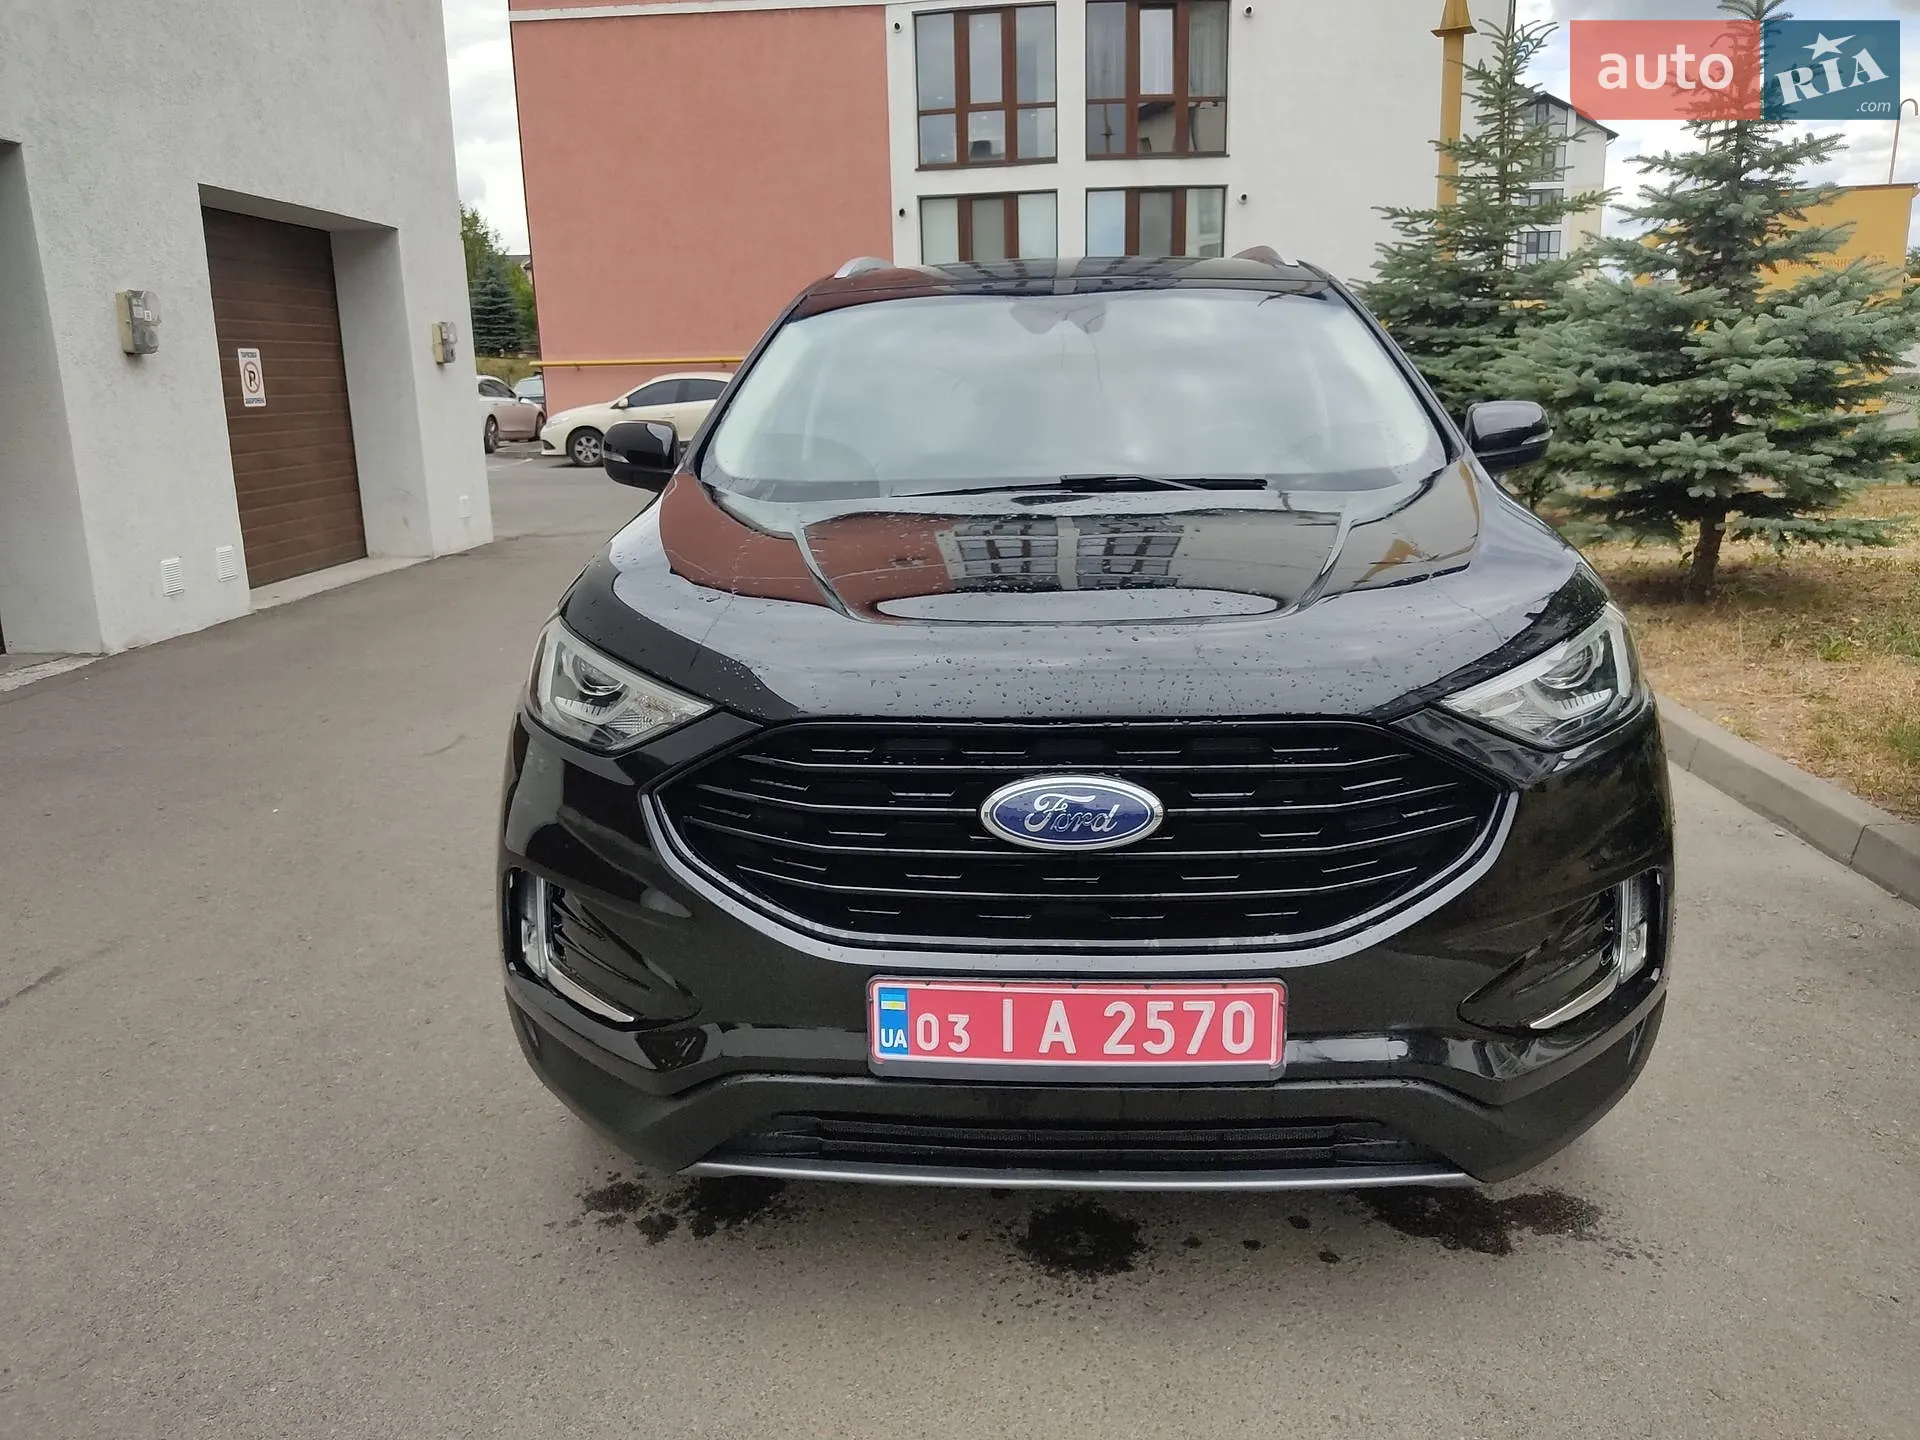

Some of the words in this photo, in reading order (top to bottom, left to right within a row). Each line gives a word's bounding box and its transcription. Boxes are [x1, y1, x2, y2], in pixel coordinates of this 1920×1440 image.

[1023, 793, 1121, 833] Ford
[880, 1028, 908, 1049] UA
[915, 1013, 971, 1052] 03
[1103, 1000, 1255, 1056] 2570
